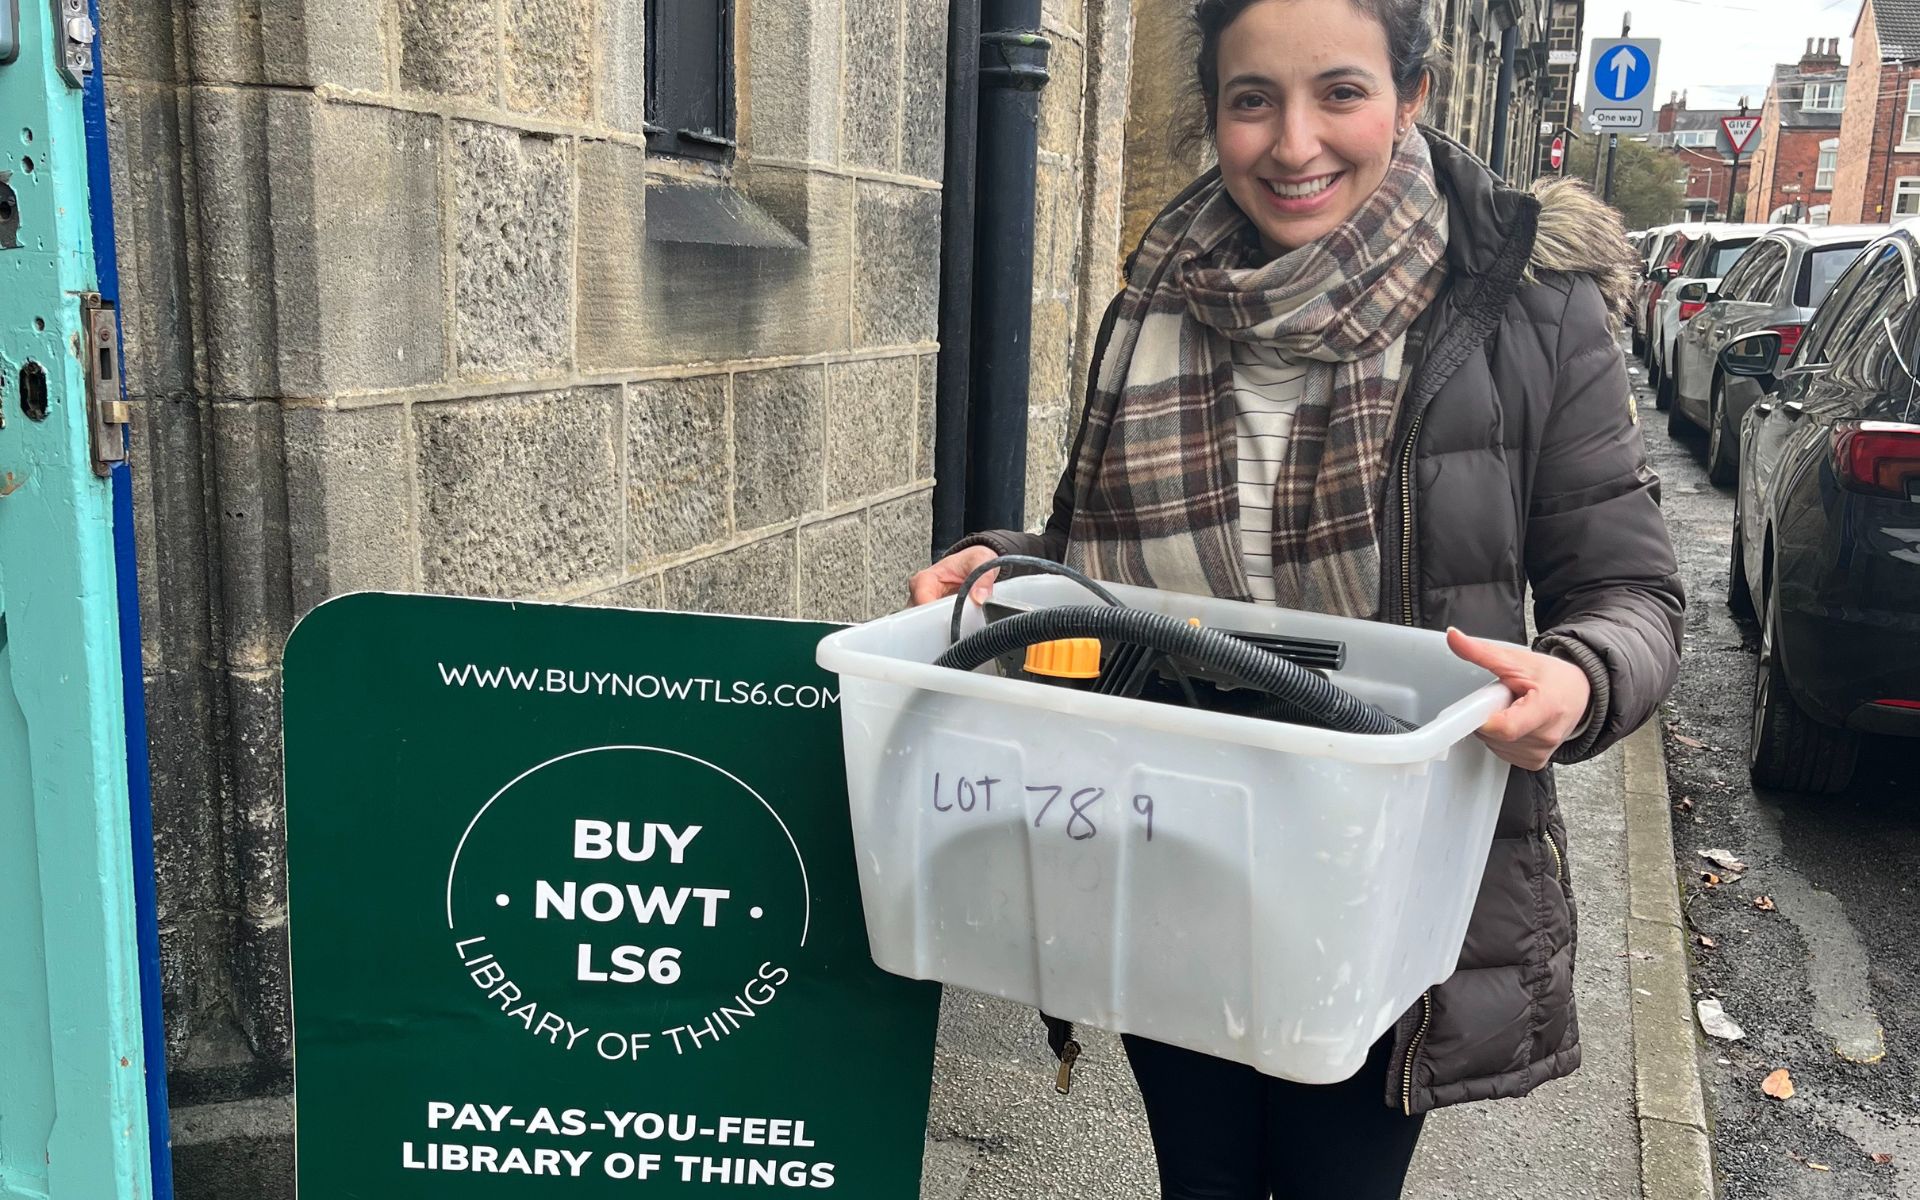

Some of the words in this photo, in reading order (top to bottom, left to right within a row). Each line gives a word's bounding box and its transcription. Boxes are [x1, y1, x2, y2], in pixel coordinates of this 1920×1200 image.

[1597, 113, 1616, 121] One
[1620, 115, 1638, 123] way
[1728, 120, 1752, 128] GIVE
[437, 662, 841, 709] WWW.BUYNOWTLS6.COM
[933, 772, 1001, 812] LOT
[573, 818, 703, 864] BUY
[535, 879, 731, 927] NOWT
[577, 943, 682, 985] LS6
[455, 936, 590, 1050] LIBRARY
[596, 1032, 652, 1061] OF
[661, 960, 789, 1055] THINGS
[428, 1101, 815, 1147] PAY-AS-YOU-FEEL
[402, 1141, 593, 1177] LIBRARY
[603, 1152, 662, 1180] OF
[674, 1155, 836, 1189] THINGS
